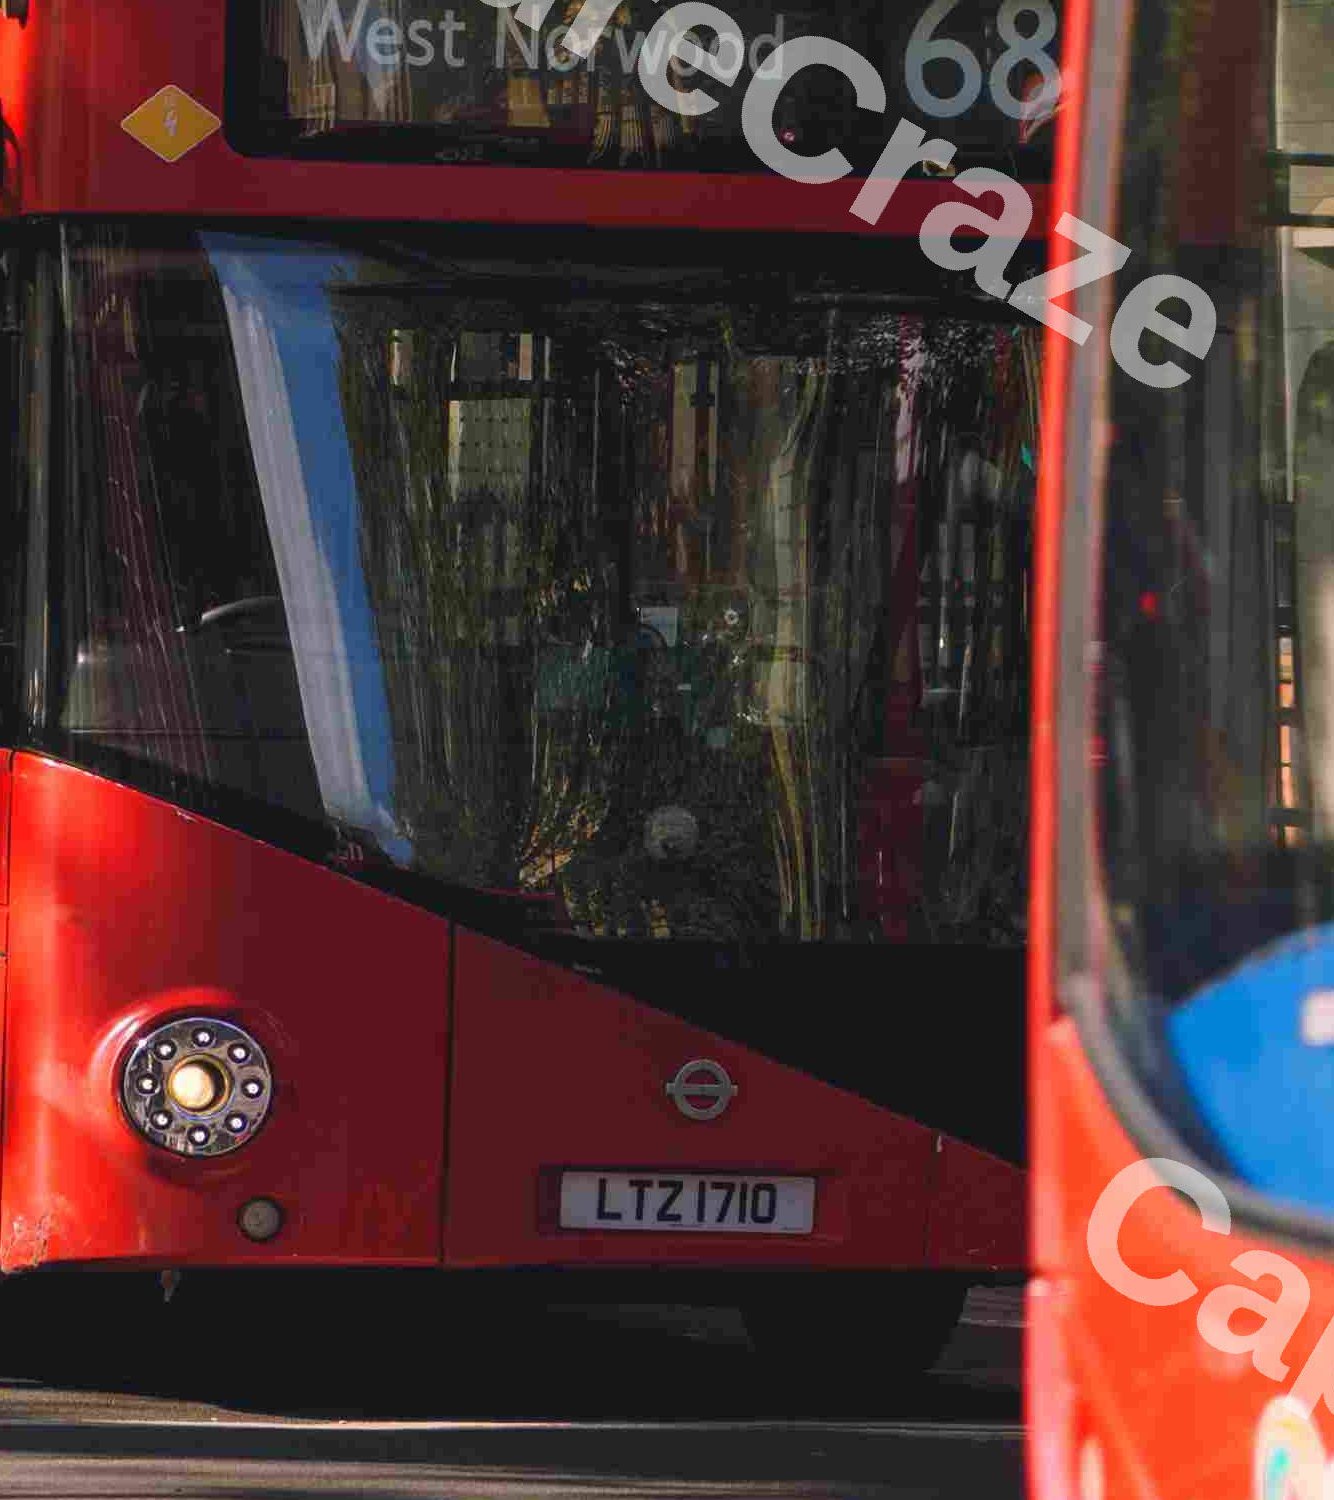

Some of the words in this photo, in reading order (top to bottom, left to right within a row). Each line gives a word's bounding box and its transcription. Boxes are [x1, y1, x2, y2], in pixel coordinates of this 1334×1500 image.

[494, 1, 785, 80] Norwood
[597, 1178, 682, 1224] LTZ
[697, 1181, 777, 1225] 1710
